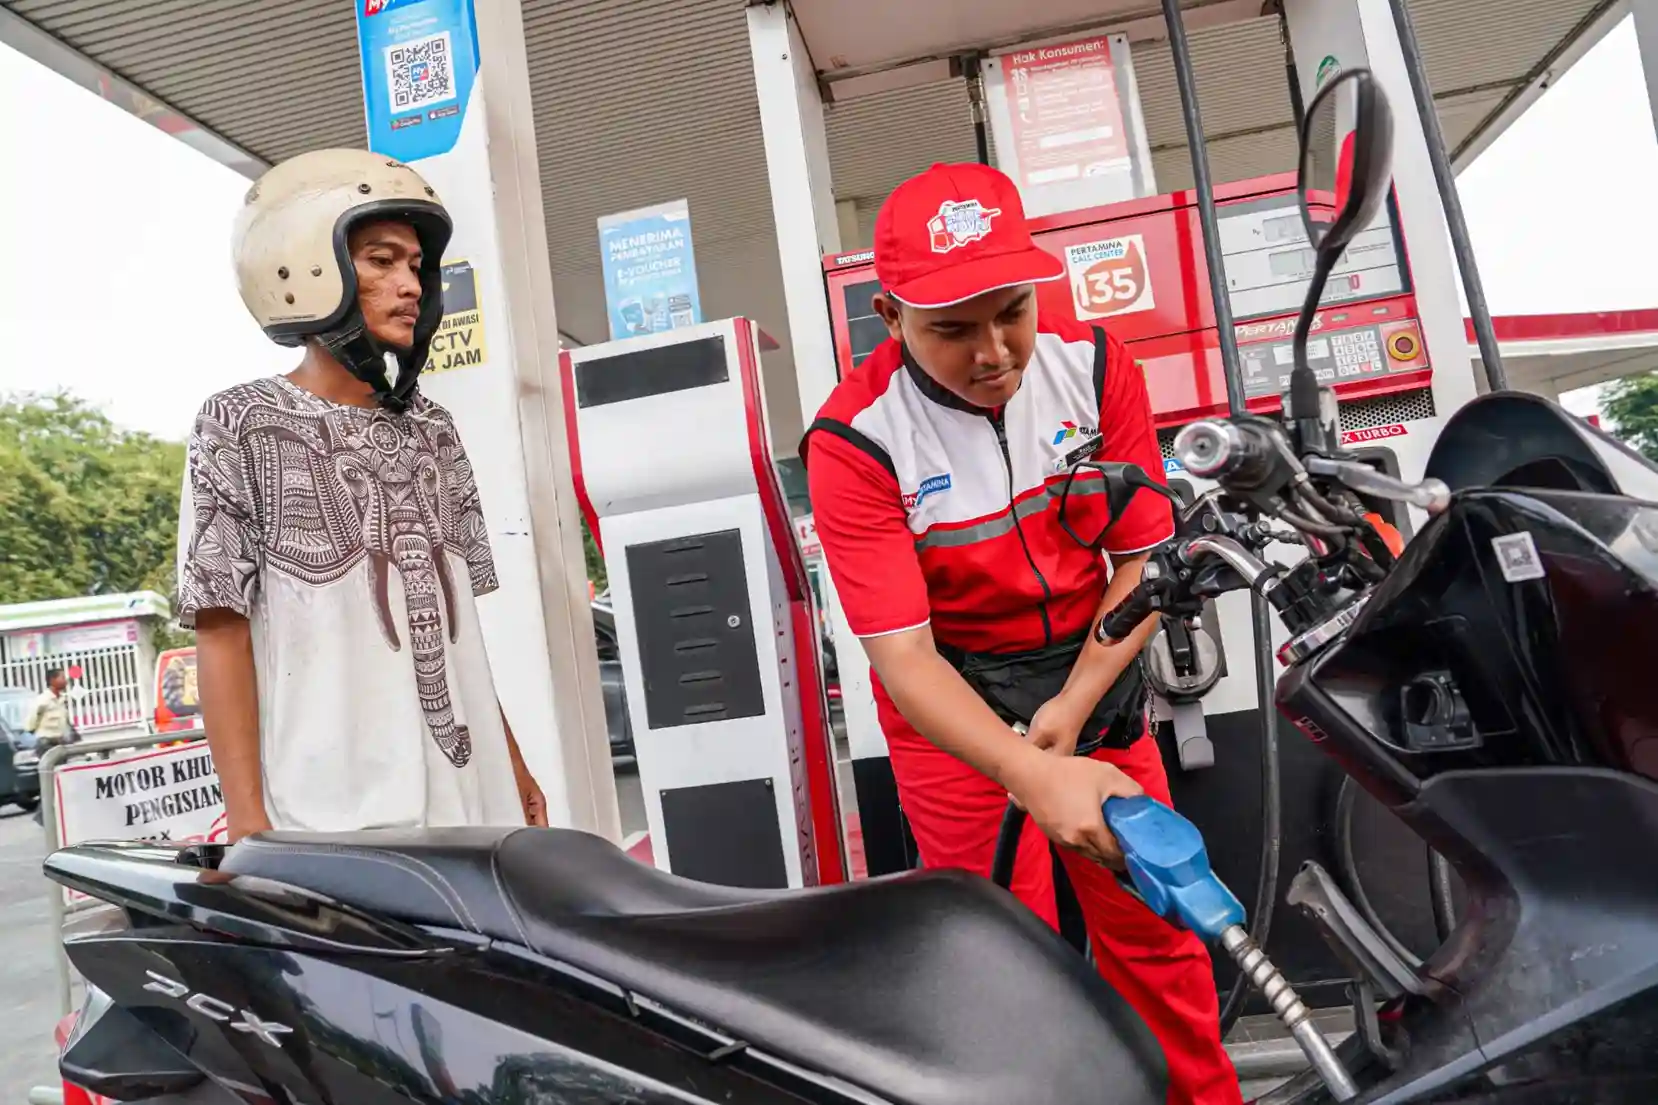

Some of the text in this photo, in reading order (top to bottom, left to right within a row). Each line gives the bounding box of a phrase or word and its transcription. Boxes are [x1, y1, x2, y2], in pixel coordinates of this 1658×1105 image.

[1012, 41, 1104, 64] Hak Konsumen:
[609, 227, 684, 252] MENERIMA
[1071, 240, 1123, 255] PERTAMINA
[1072, 248, 1124, 264] CALL CENTER
[452, 313, 480, 328] AWASI
[442, 348, 482, 370] JAM
[1355, 424, 1403, 440] TURBO
[95, 754, 218, 799] MOTOR KHU
[125, 782, 224, 826] PENGISIAN
